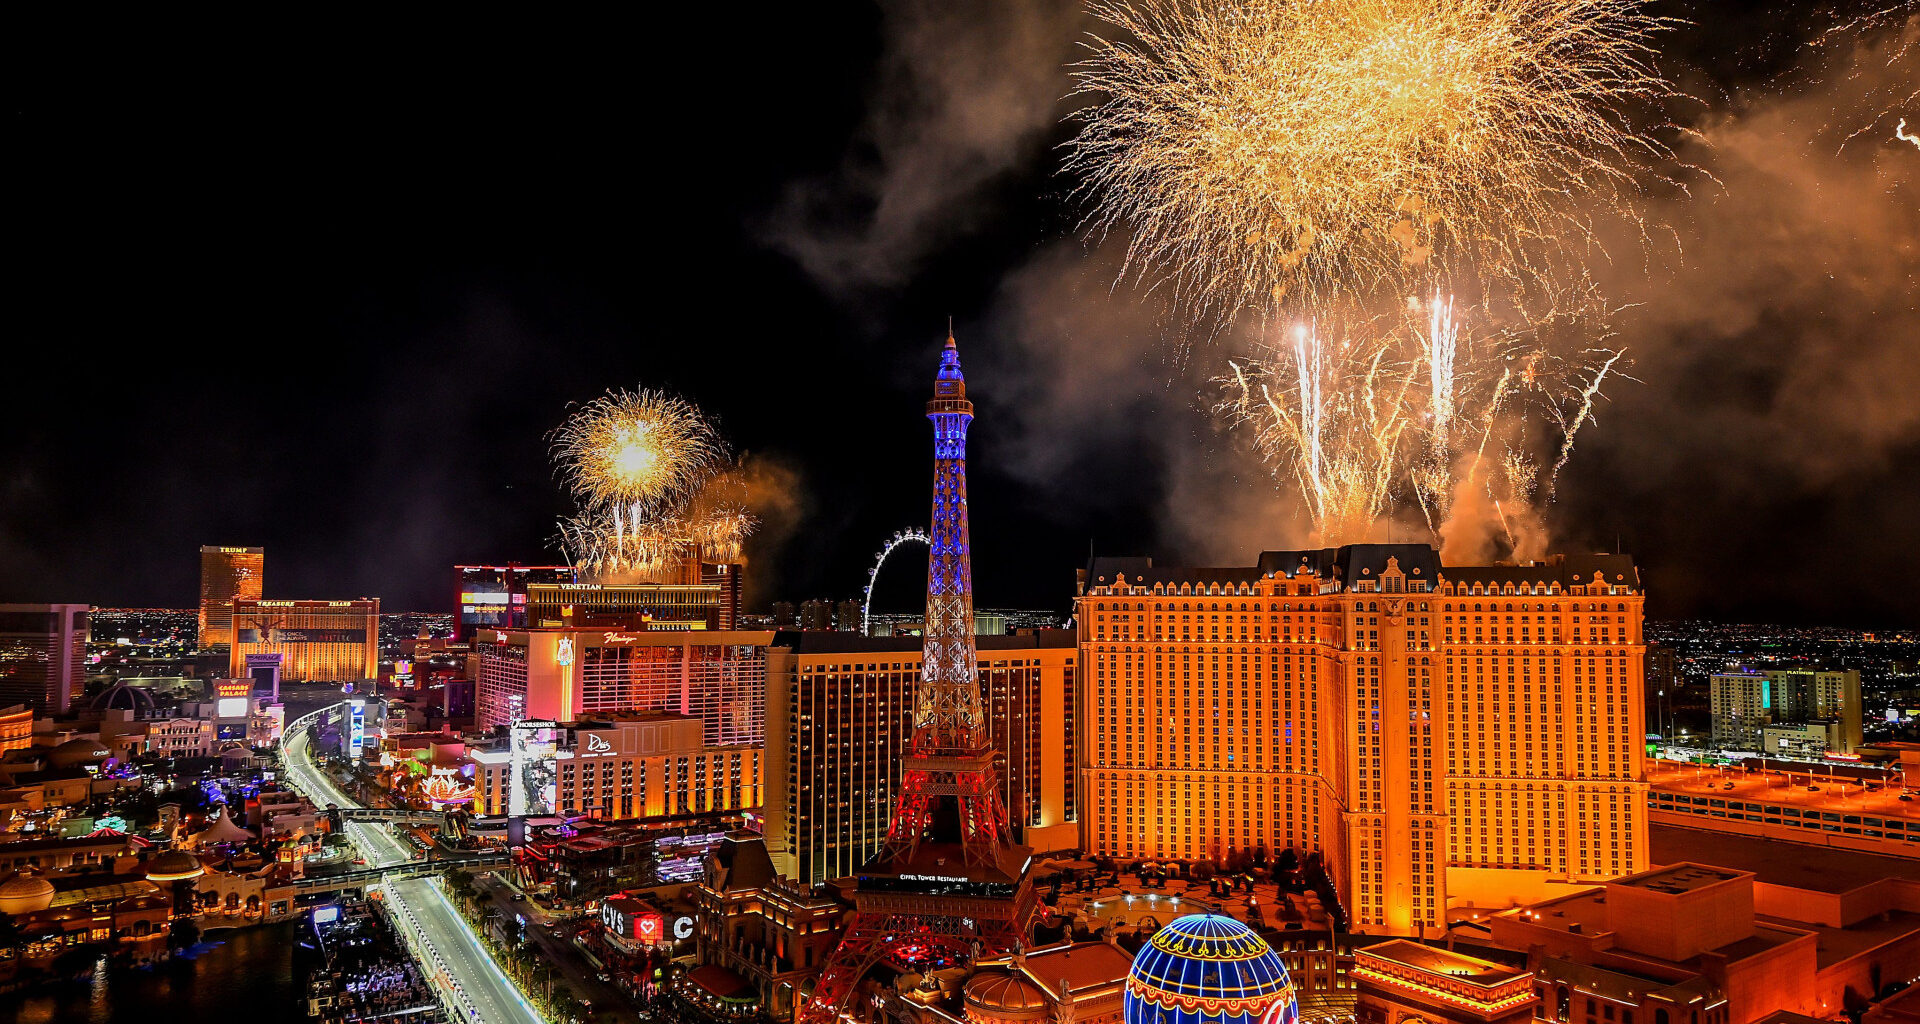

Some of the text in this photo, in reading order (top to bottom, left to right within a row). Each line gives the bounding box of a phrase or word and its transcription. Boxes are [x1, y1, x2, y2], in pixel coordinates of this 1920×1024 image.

[603, 632, 637, 644] Flamingo
[900, 873, 917, 881] EIFFEL
[937, 875, 968, 883] RESTAURANT
[602, 903, 624, 935] CVS
